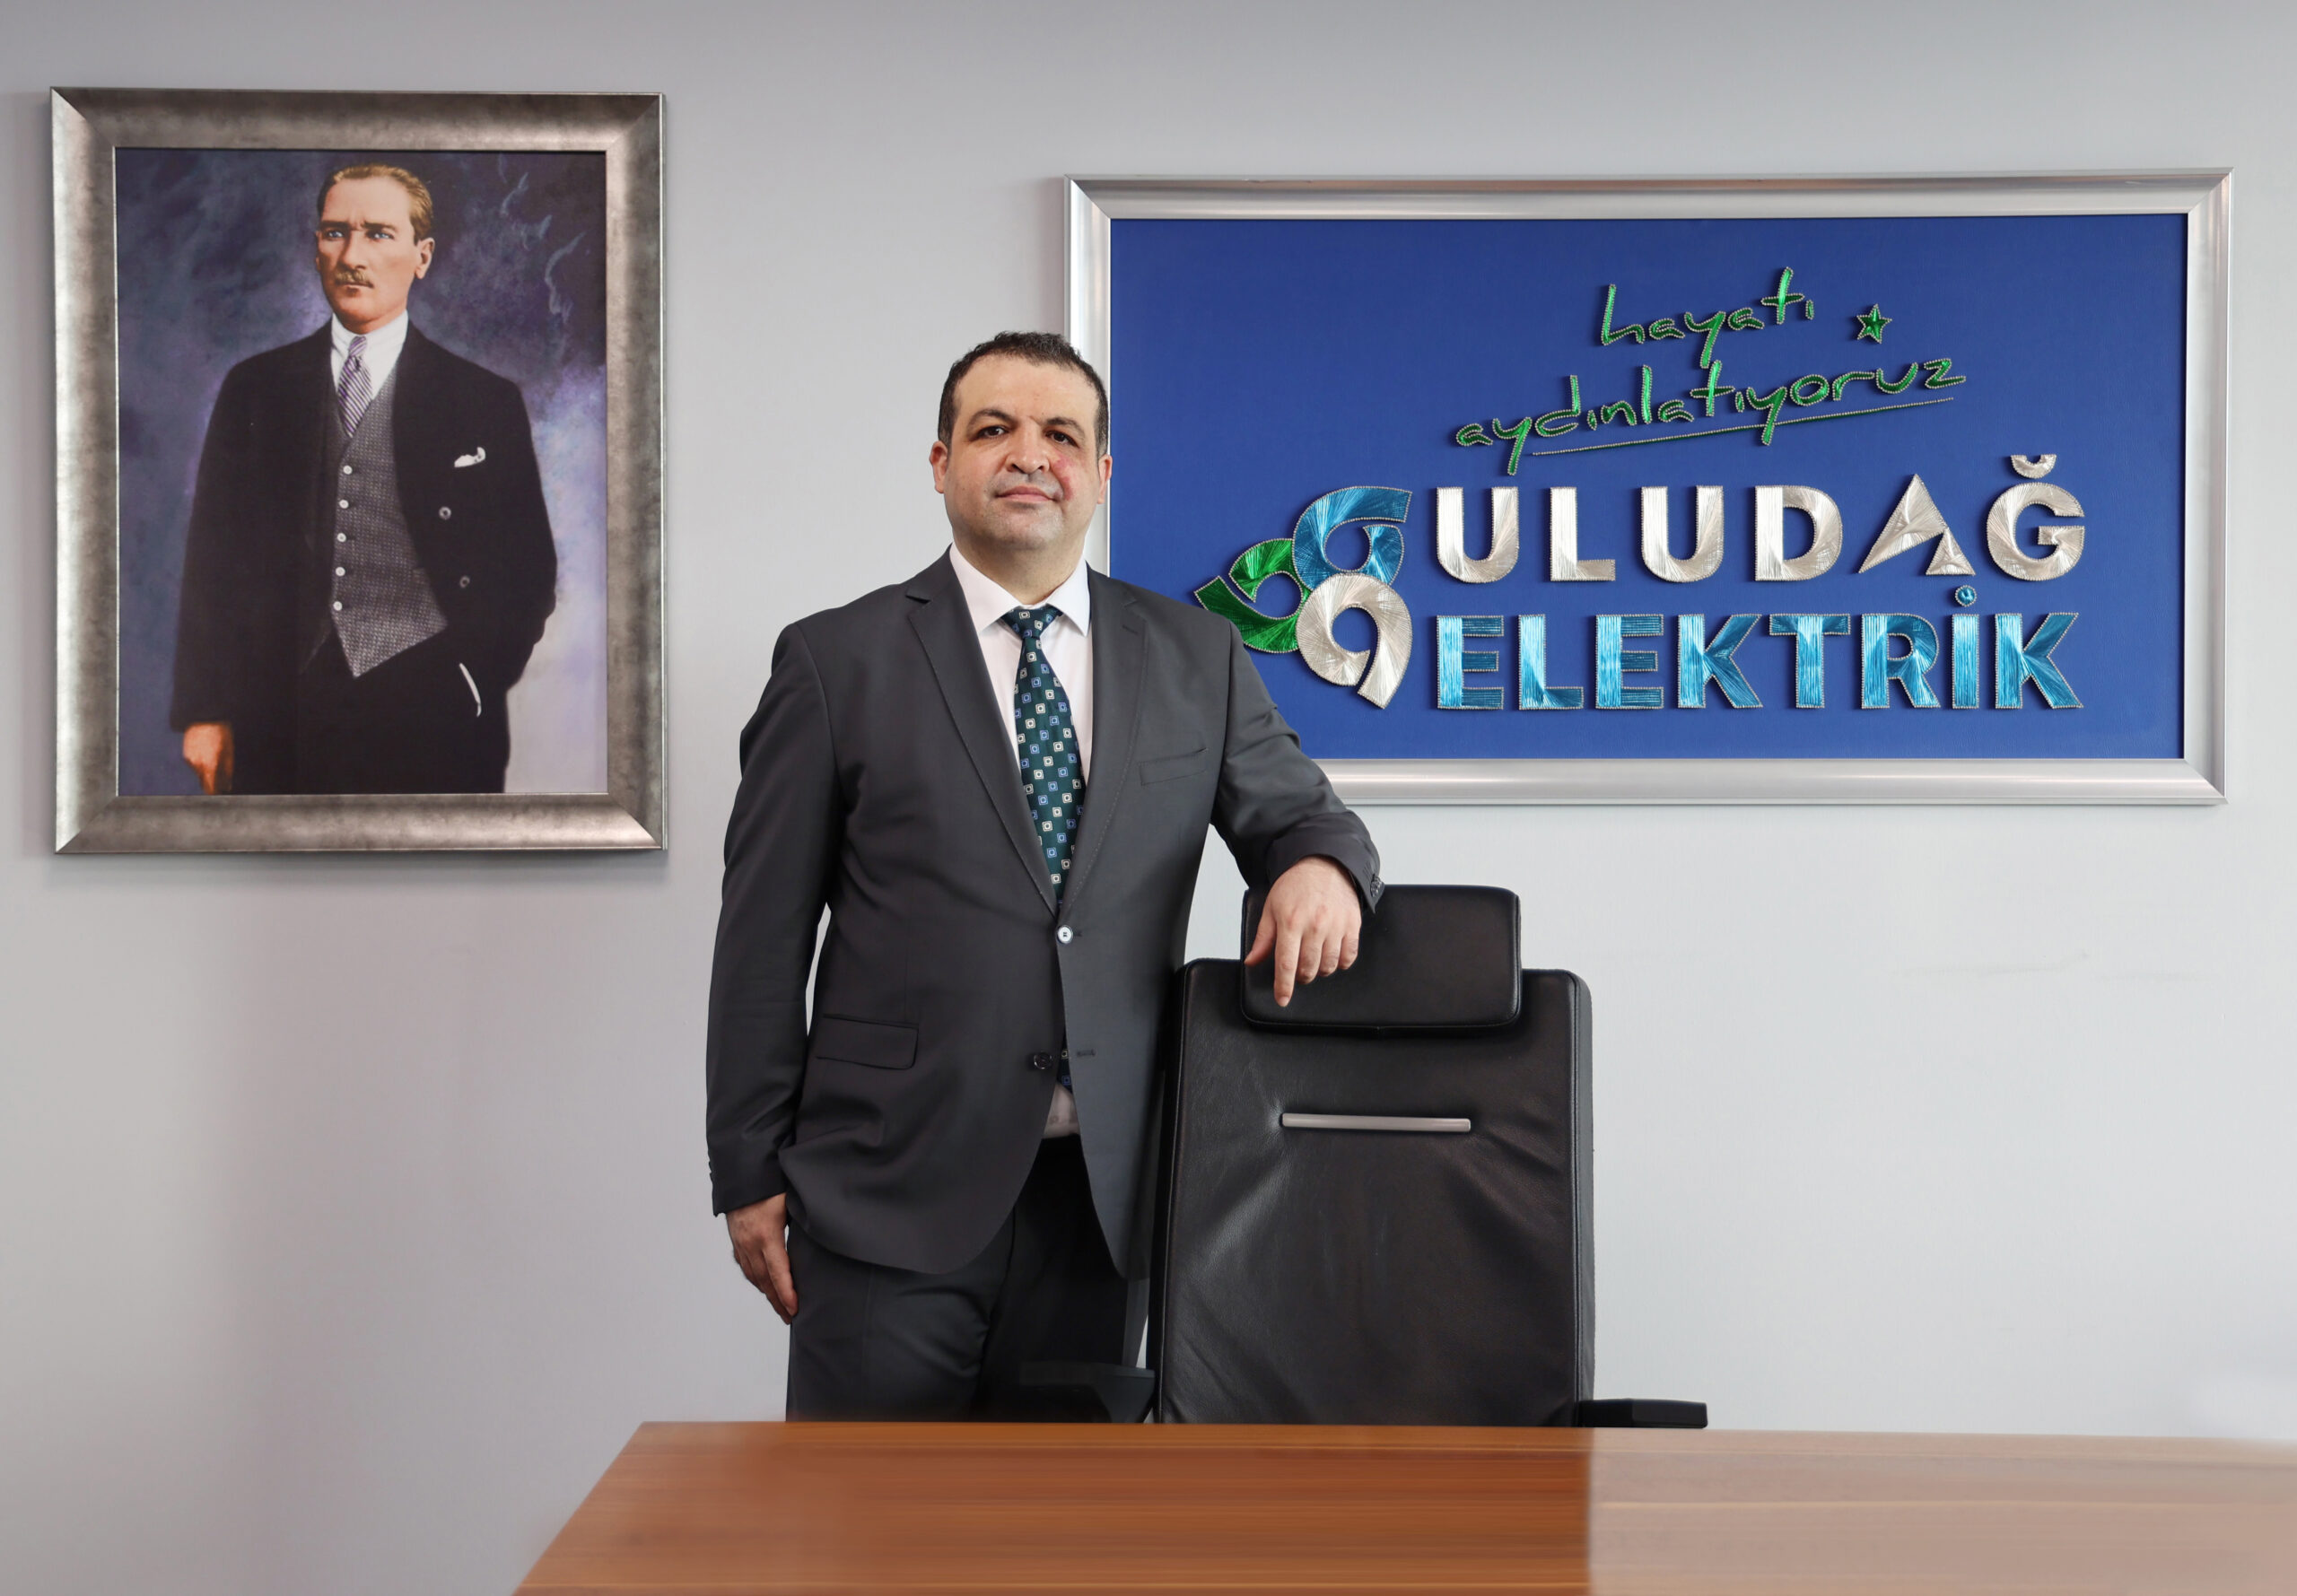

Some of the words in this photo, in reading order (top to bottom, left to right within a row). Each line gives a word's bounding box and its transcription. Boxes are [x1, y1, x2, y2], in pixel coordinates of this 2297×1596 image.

[1601, 266, 1814, 369] hayatı
[1455, 358, 1966, 475] aydınlatıyoruz
[1436, 454, 2086, 583] ULUDAĞ
[1436, 584, 2084, 711] ELEKTRİK
